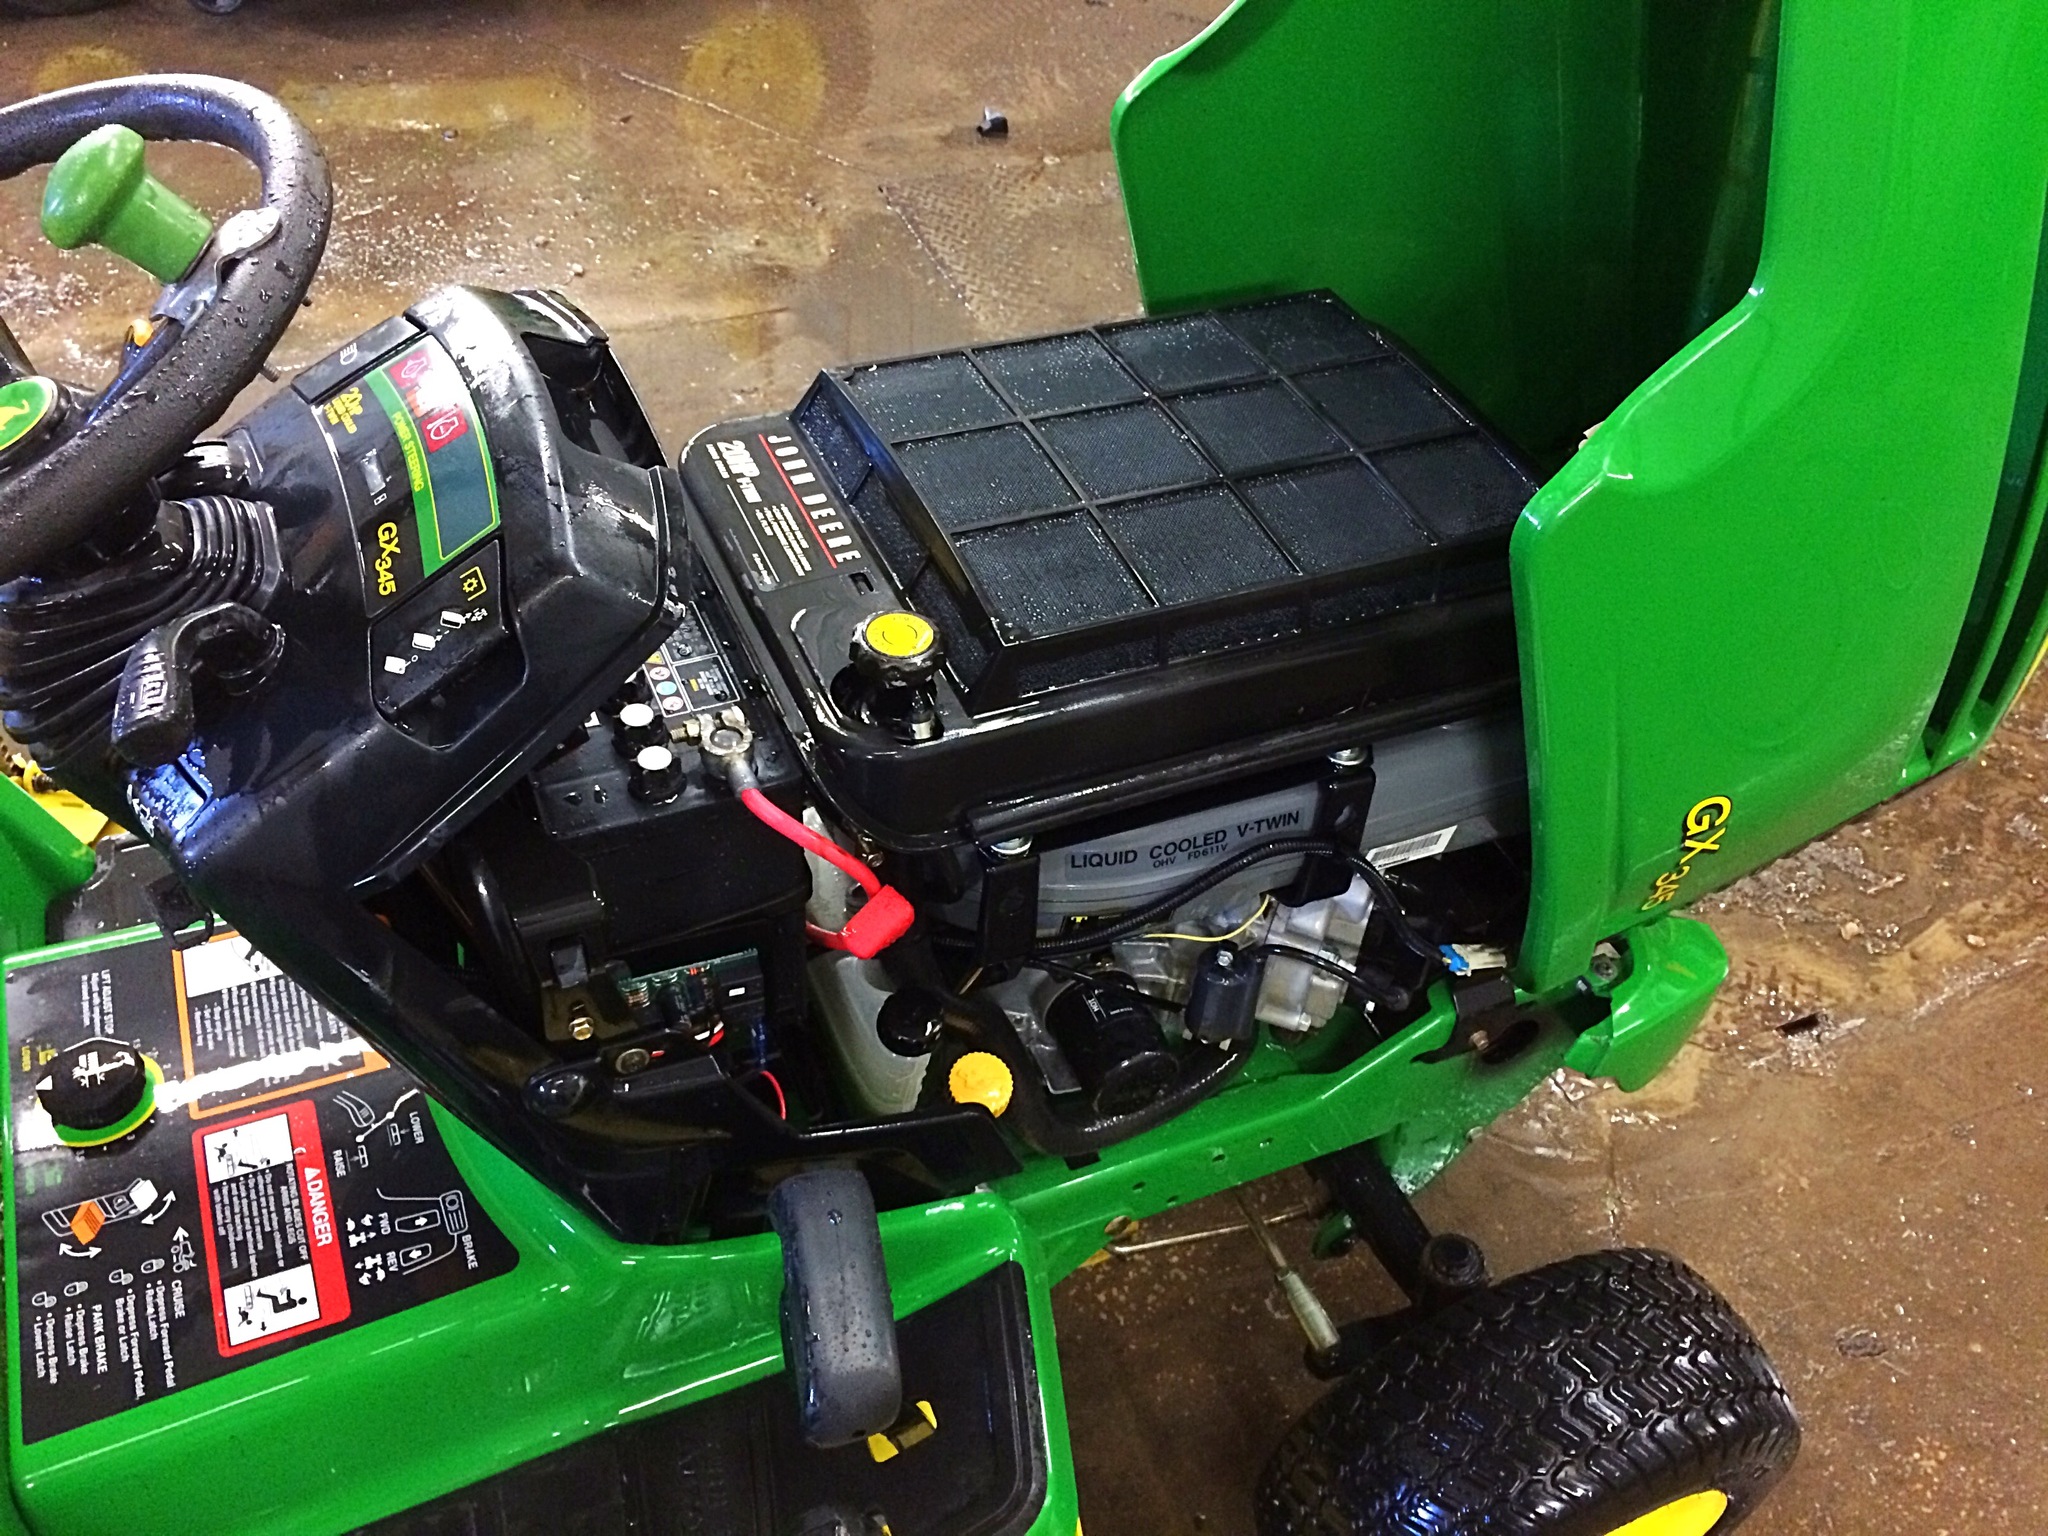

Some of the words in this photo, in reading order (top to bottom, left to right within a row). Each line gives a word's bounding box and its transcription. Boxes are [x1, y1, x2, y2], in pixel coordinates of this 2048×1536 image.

[403, 440, 424, 492] STEERING
[767, 436, 815, 484] JOHN
[802, 494, 861, 561] DEERE
[378, 522, 401, 559] GX
[375, 556, 396, 595] 345
[1071, 850, 1138, 869] LIQUID
[1150, 829, 1227, 860] COOLED
[1237, 811, 1299, 838] V-TWIN
[1679, 795, 1732, 865] GX
[1153, 856, 1177, 869] OHV
[1187, 843, 1228, 860] FD611V
[1641, 866, 1690, 910] 345
[101, 969, 111, 984] LIFT
[102, 986, 113, 1013] ADJUST
[104, 1014, 114, 1034] STOP
[409, 1111, 424, 1144] LOWER
[333, 1149, 346, 1178] RAISE
[284, 1208, 292, 1223] AND
[307, 1179, 332, 1246] DANGER
[378, 1212, 391, 1235] FWD
[286, 1223, 296, 1244] LEGS
[296, 1228, 306, 1244] CUT
[299, 1245, 308, 1260] OFF
[386, 1251, 398, 1271] REV
[462, 1234, 478, 1269] BRAKE
[115, 1297, 125, 1323] Brake
[125, 1294, 137, 1331] Depress
[155, 1285, 166, 1322] Depress
[171, 1280, 185, 1319] CRUISE
[64, 1313, 74, 1339] Raise
[75, 1309, 86, 1347] Depress
[92, 1304, 104, 1335] PARK
[148, 1314, 158, 1340] Latch
[34, 1322, 43, 1350] Lower
[44, 1318, 55, 1356] Depress
[119, 1336, 130, 1362] Latch
[160, 1322, 173, 1360] Forward
[36, 1351, 46, 1378] Latch
[66, 1340, 76, 1366] Latch
[79, 1347, 89, 1375] Brake
[94, 1335, 108, 1374] BRAKE
[130, 1331, 142, 1370] Forward
[48, 1356, 59, 1384] Brake
[165, 1361, 176, 1388] Pedal
